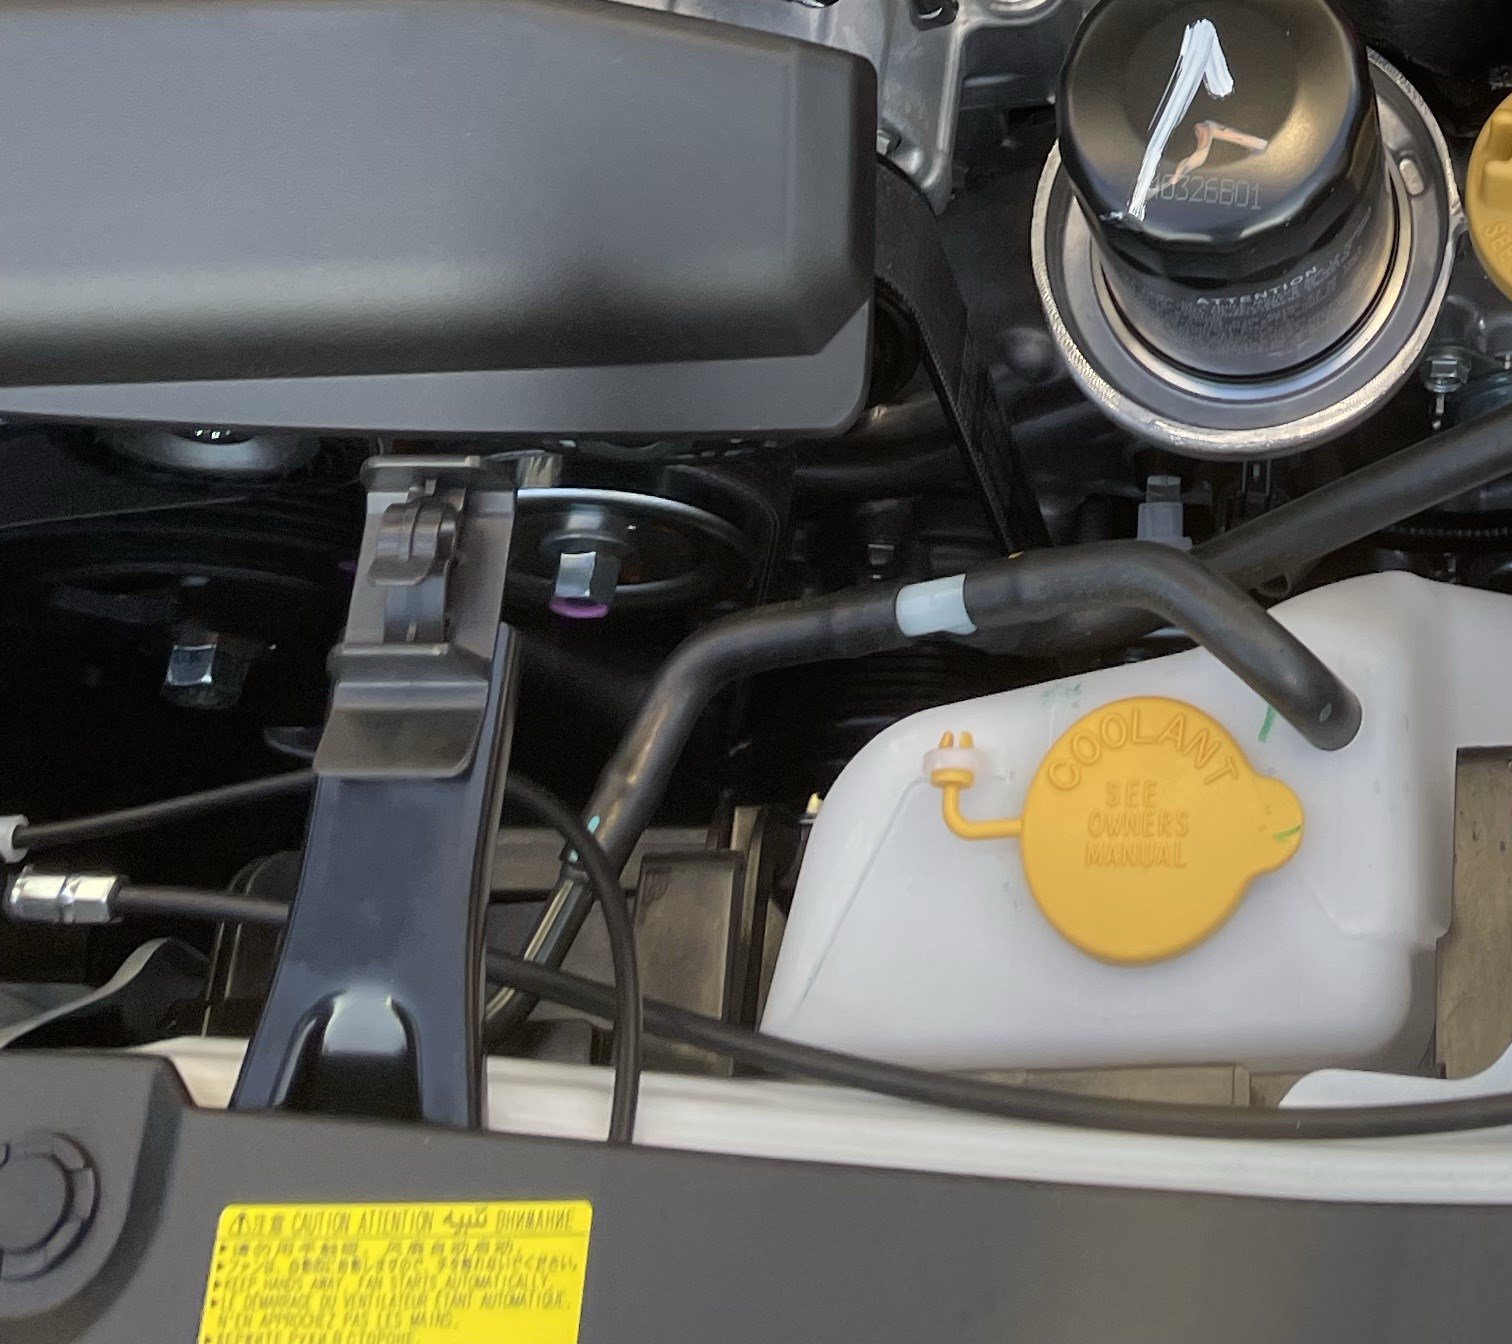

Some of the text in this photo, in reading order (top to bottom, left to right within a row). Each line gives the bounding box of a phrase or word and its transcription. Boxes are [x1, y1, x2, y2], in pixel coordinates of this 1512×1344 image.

[1197, 265, 1318, 306] ATTENTION
[1048, 708, 1240, 791] COOLANT
[1105, 778, 1158, 809] SEE
[1087, 811, 1190, 838] OWNERS
[1085, 841, 1188, 868] MANUAL
[292, 1209, 351, 1235] CAUTION
[359, 1208, 434, 1235] ATTENTION
[496, 1208, 572, 1234] ВНИМАНИЕ
